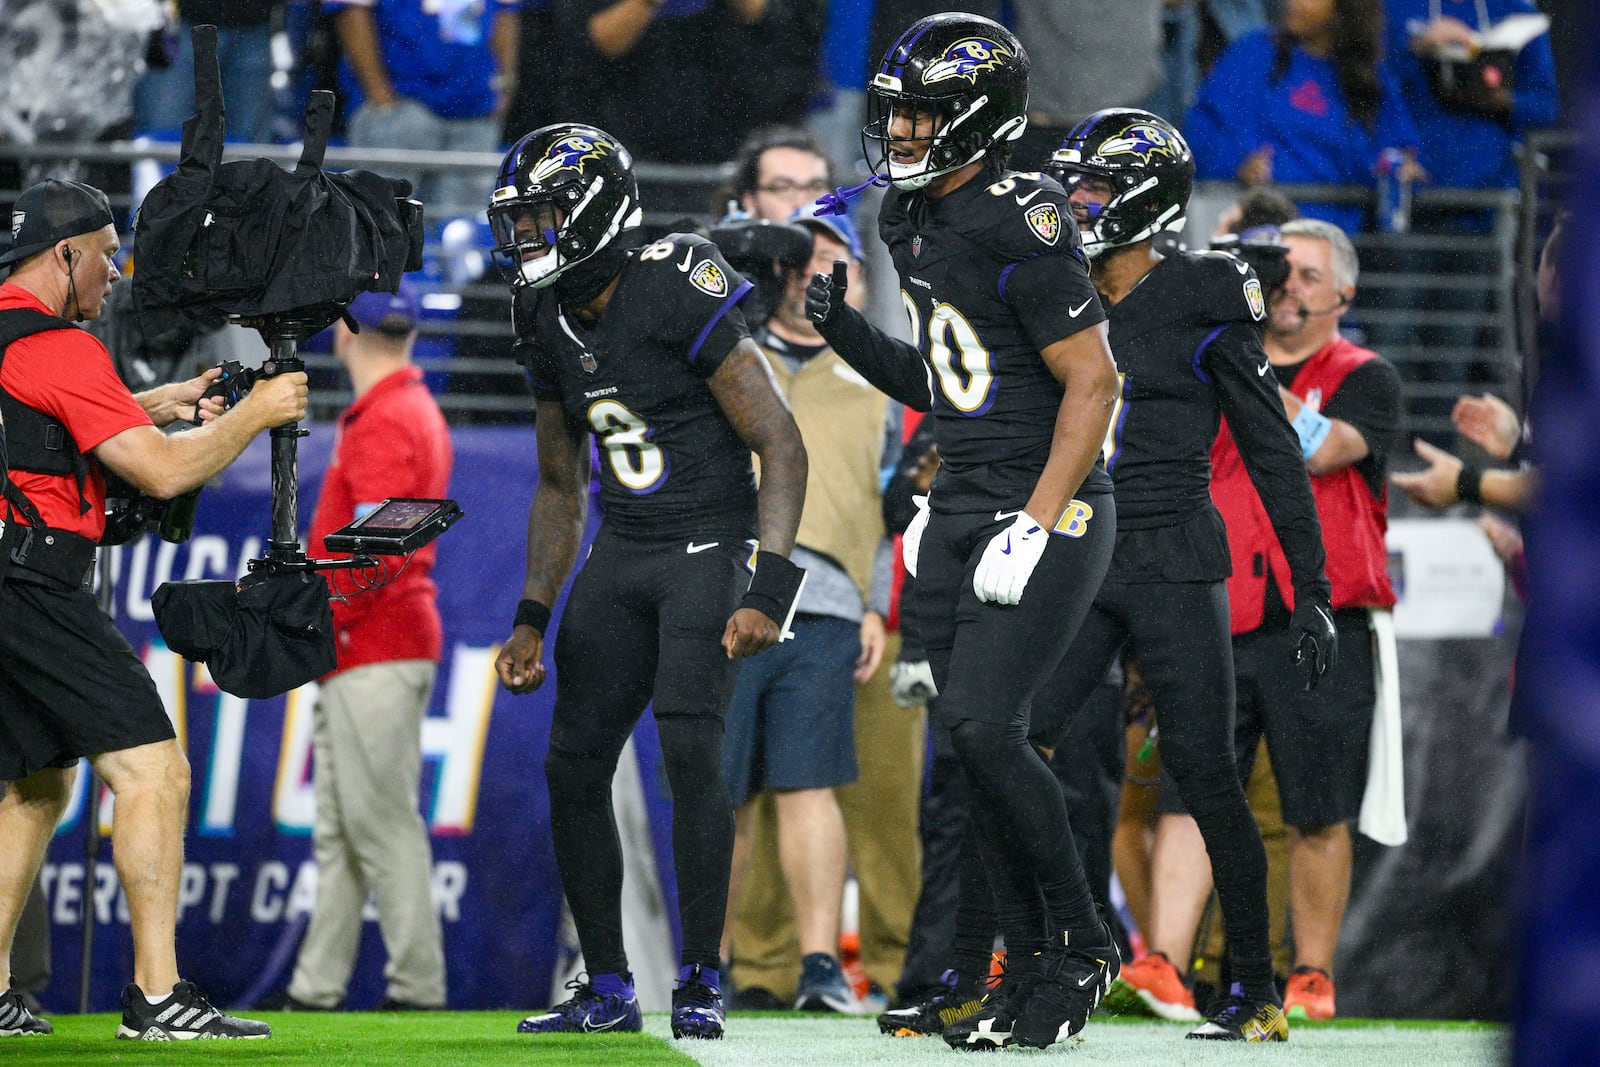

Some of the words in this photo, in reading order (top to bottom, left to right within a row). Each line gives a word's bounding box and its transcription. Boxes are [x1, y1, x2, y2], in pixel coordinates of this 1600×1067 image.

[909, 276, 932, 290] RAVENS
[584, 386, 618, 399] RAVENS
[587, 398, 670, 495] 8
[1052, 499, 1093, 538] B
